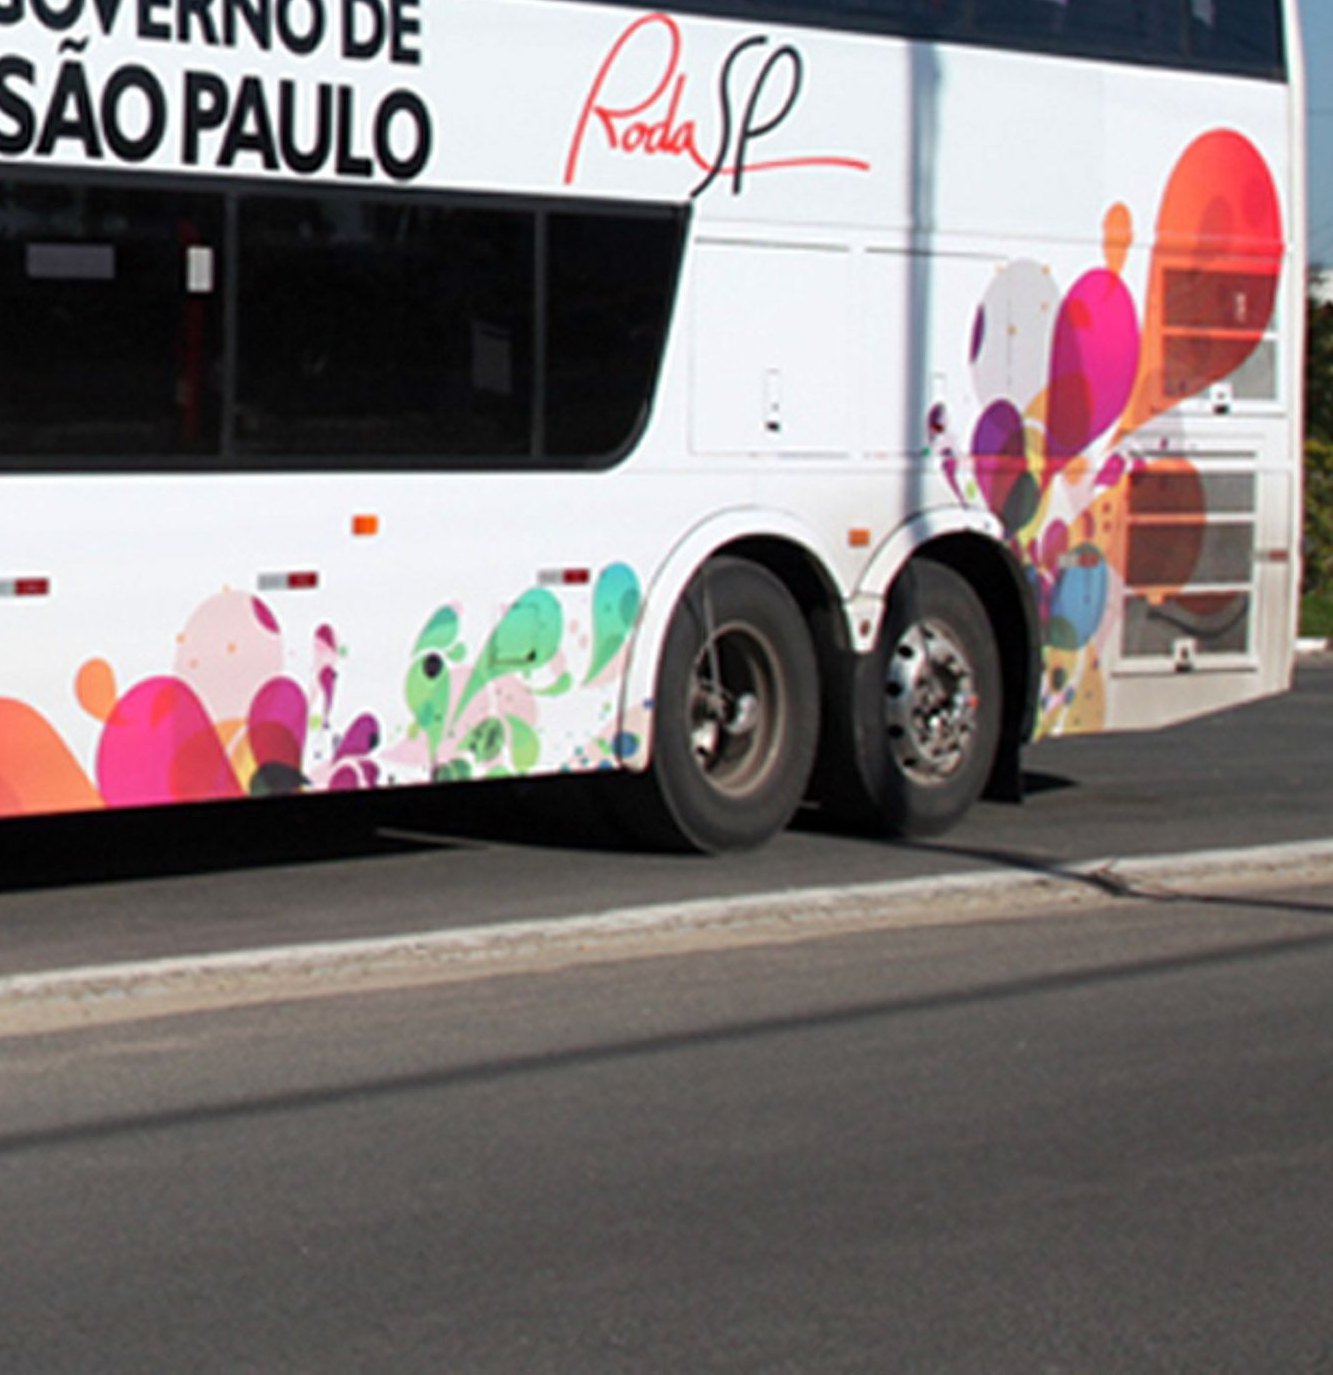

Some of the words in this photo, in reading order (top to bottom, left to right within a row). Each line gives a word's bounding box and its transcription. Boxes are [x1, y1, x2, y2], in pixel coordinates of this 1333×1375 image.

[181, 69, 432, 181] PAULO
[562, 10, 703, 186] Roda
[689, 33, 804, 200] SP
